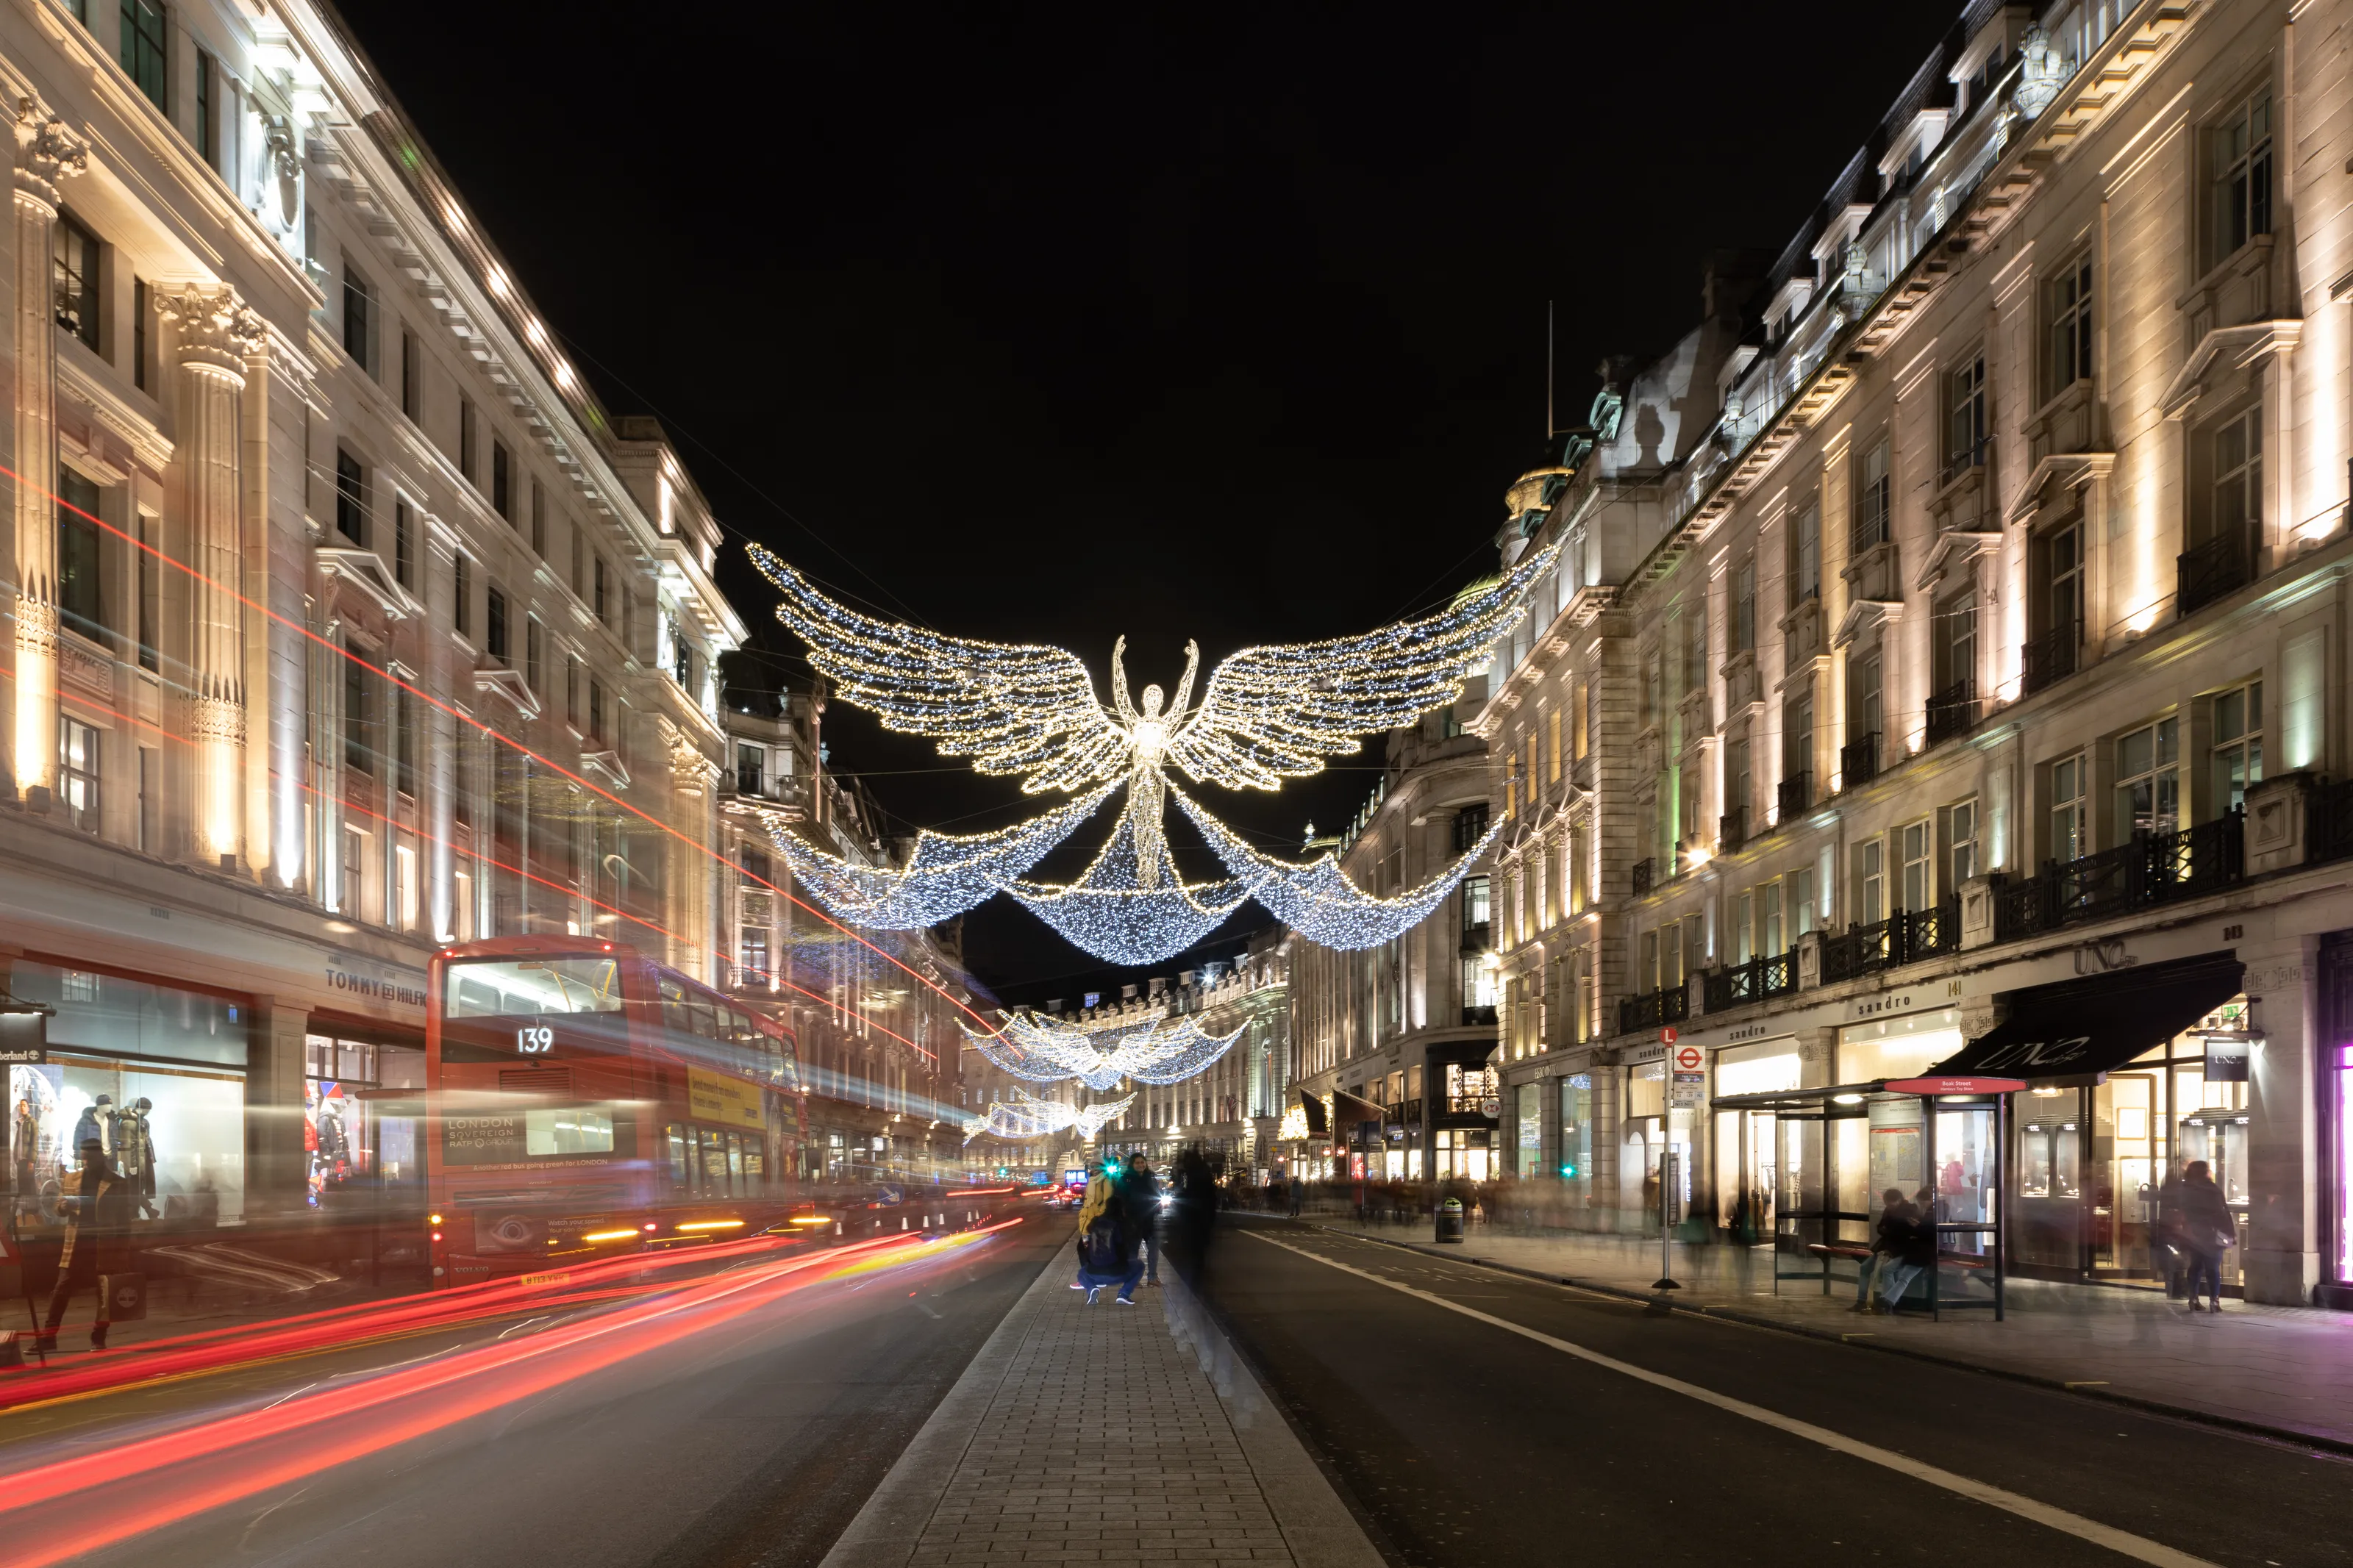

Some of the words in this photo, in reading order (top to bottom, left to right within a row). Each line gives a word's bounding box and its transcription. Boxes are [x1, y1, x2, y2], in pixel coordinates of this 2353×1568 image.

[326, 969, 379, 996] TOMMY
[1949, 980, 1962, 997] 141
[1858, 995, 1911, 1015] sandro
[1665, 1029, 1674, 1042] L
[1729, 1025, 1766, 1041] sandro
[518, 1027, 552, 1053] 139
[1639, 1047, 1665, 1059] sandro
[2215, 1056, 2237, 1064] UNO
[1535, 1066, 1545, 1079] HSBC
[449, 1117, 513, 1129] LONDON
[449, 1129, 513, 1139] SOVEREIGN
[526, 1161, 545, 1170] going
[576, 1159, 608, 1167] LONDON
